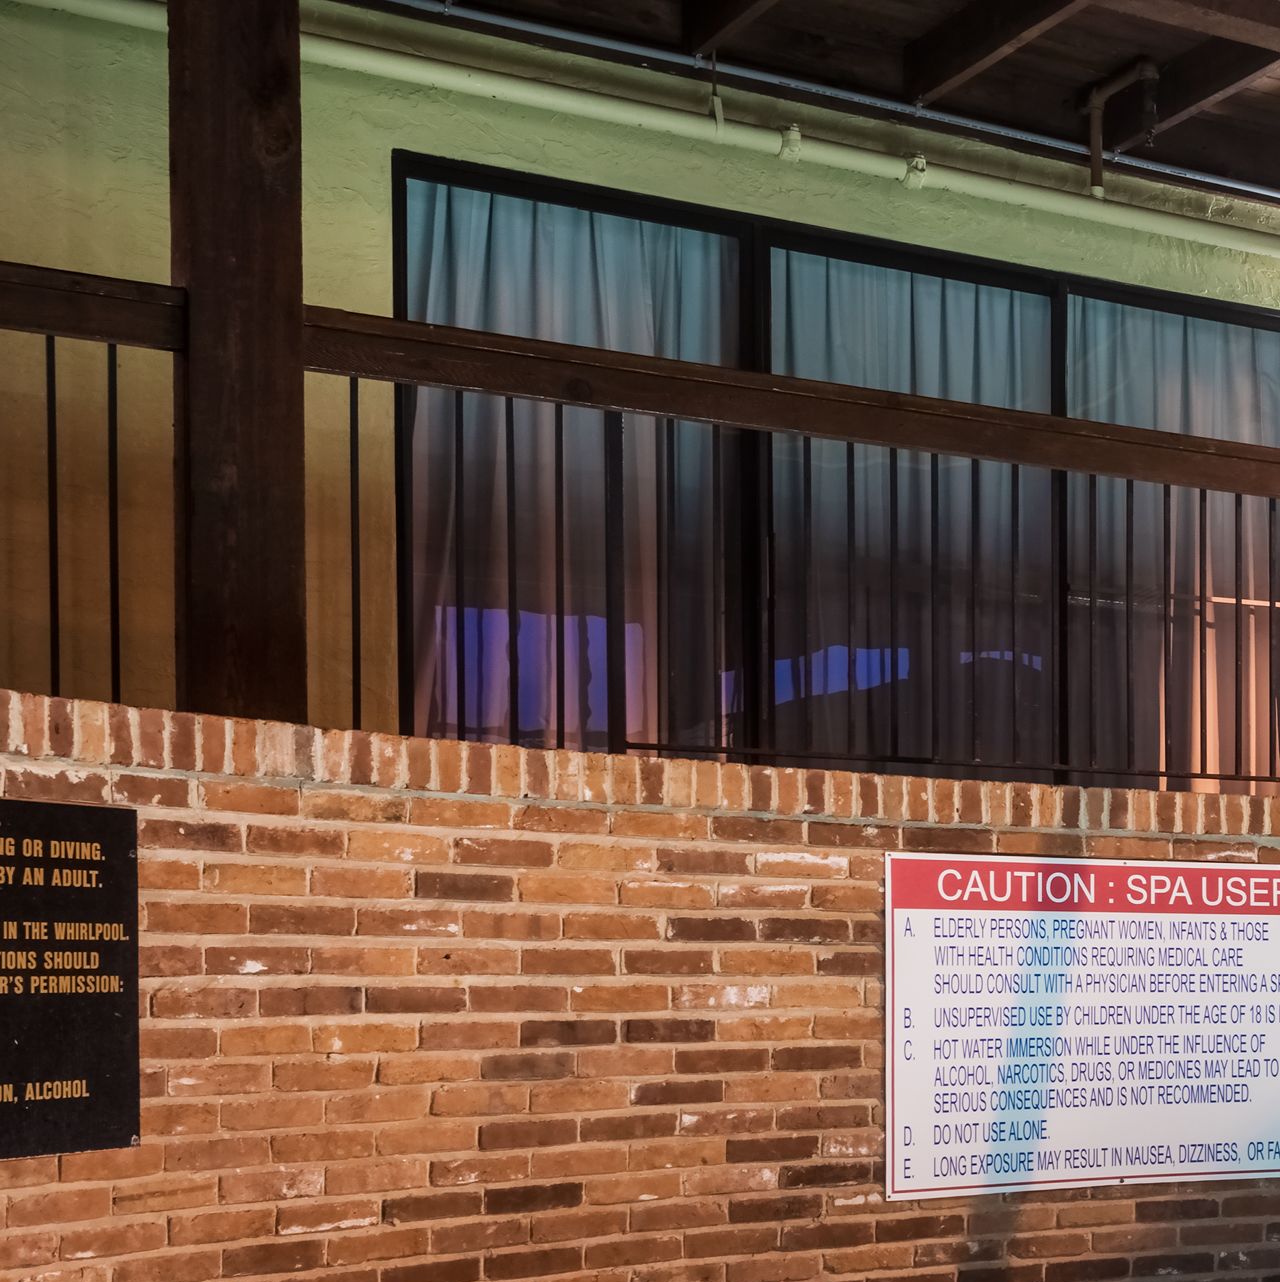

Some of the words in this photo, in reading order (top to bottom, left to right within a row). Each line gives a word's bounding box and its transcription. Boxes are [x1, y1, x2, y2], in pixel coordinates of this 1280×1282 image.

[22, 838, 43, 858] OR
[50, 840, 106, 861] DIVING.
[23, 867, 45, 886] AN
[51, 869, 103, 888] ADULT.
[937, 868, 1095, 904] CAUTION
[1126, 874, 1192, 905] SPA
[3, 922, 17, 940] IN
[23, 922, 48, 940] THE
[54, 923, 129, 940] WHIRLPOOL.
[904, 917, 915, 937] A.
[934, 918, 987, 938] ELDERLY
[990, 919, 1050, 942] PERSONS,
[1053, 919, 1115, 940] PREGNANT
[1118, 921, 1166, 943] WOMEN,
[1169, 922, 1217, 941] INFANTS
[1220, 922, 1227, 941] &
[1231, 922, 1269, 941] THOSE
[0, 951, 37, 970] IONS
[43, 952, 100, 970] SHOULD
[934, 946, 964, 966] WITH
[969, 946, 1013, 966] HEALTH
[1016, 946, 1088, 966] CONDITIONS
[1091, 946, 1155, 967] REQUIRING
[1158, 948, 1208, 967] MEDICAL
[1212, 948, 1244, 967] CARE
[30, 976, 123, 994] PERMISSION:
[934, 973, 983, 994] SHOULD
[987, 973, 1041, 994] CONSULT
[1044, 973, 1073, 993] WITH
[1075, 973, 1083, 993] A
[1085, 973, 1146, 993] PHYSICIAN
[1150, 973, 1196, 993] BEFORE
[1199, 973, 1257, 993] ENTERING
[1260, 973, 1268, 993] A
[904, 1007, 915, 1029] B.
[934, 1006, 1026, 1028] UNSUPERVISED
[1029, 1006, 1053, 1026] USE
[1056, 1006, 1071, 1026] BY
[1074, 1005, 1131, 1025] CHILDREN
[1135, 1005, 1175, 1025] UNDER
[1178, 1005, 1200, 1024] THE
[1203, 1005, 1227, 1024] AGE
[1230, 1005, 1246, 1024] OF
[1250, 1005, 1262, 1024] 18
[1265, 1004, 1276, 1024] IS
[903, 1040, 915, 1061] C.
[934, 1039, 959, 1060] HOT
[961, 1038, 1003, 1059] WATER
[1006, 1036, 1071, 1058] IMMERSION
[1075, 1036, 1110, 1056] WHILE
[1114, 1035, 1154, 1055] UNDER
[1157, 1035, 1180, 1054] THE
[1183, 1034, 1247, 1054] INFLUENCE
[1250, 1034, 1266, 1053] OF
[934, 1065, 994, 1088] ALCOHOL,
[997, 1062, 1067, 1086] NARCOTICS,
[1071, 1062, 1114, 1084] DRUGS,
[1118, 1061, 1135, 1081] OR
[1138, 1060, 1201, 1080] MEDICINES
[1204, 1060, 1228, 1078] MAY
[1231, 1059, 1261, 1078] LEAD
[1264, 1058, 1279, 1077] TO
[25, 1080, 89, 1100] ALCOHOL
[934, 1091, 987, 1113] SERIOUS
[990, 1088, 1087, 1111] CONSEQUENCES
[1090, 1087, 1113, 1107] AND
[1117, 1087, 1128, 1106] IS
[1131, 1086, 1155, 1105] NOT
[1158, 1083, 1252, 1104] RECOMMENDED.
[904, 1126, 915, 1146] D.
[934, 1124, 951, 1145] DO
[954, 1123, 979, 1144] NOT
[982, 1122, 1006, 1143] USE
[1008, 1119, 1050, 1141] ALONE.
[904, 1158, 914, 1179] E.
[934, 1156, 967, 1177] LONG
[970, 1152, 1034, 1175] EXPOSURE
[1037, 1150, 1062, 1170] MAY
[1065, 1148, 1108, 1169] RESULT
[1111, 1147, 1122, 1166] IN
[1125, 1145, 1175, 1166] NAUSEA,
[1179, 1142, 1241, 1164] DIZZINESS,
[1247, 1142, 1264, 1161] OR
